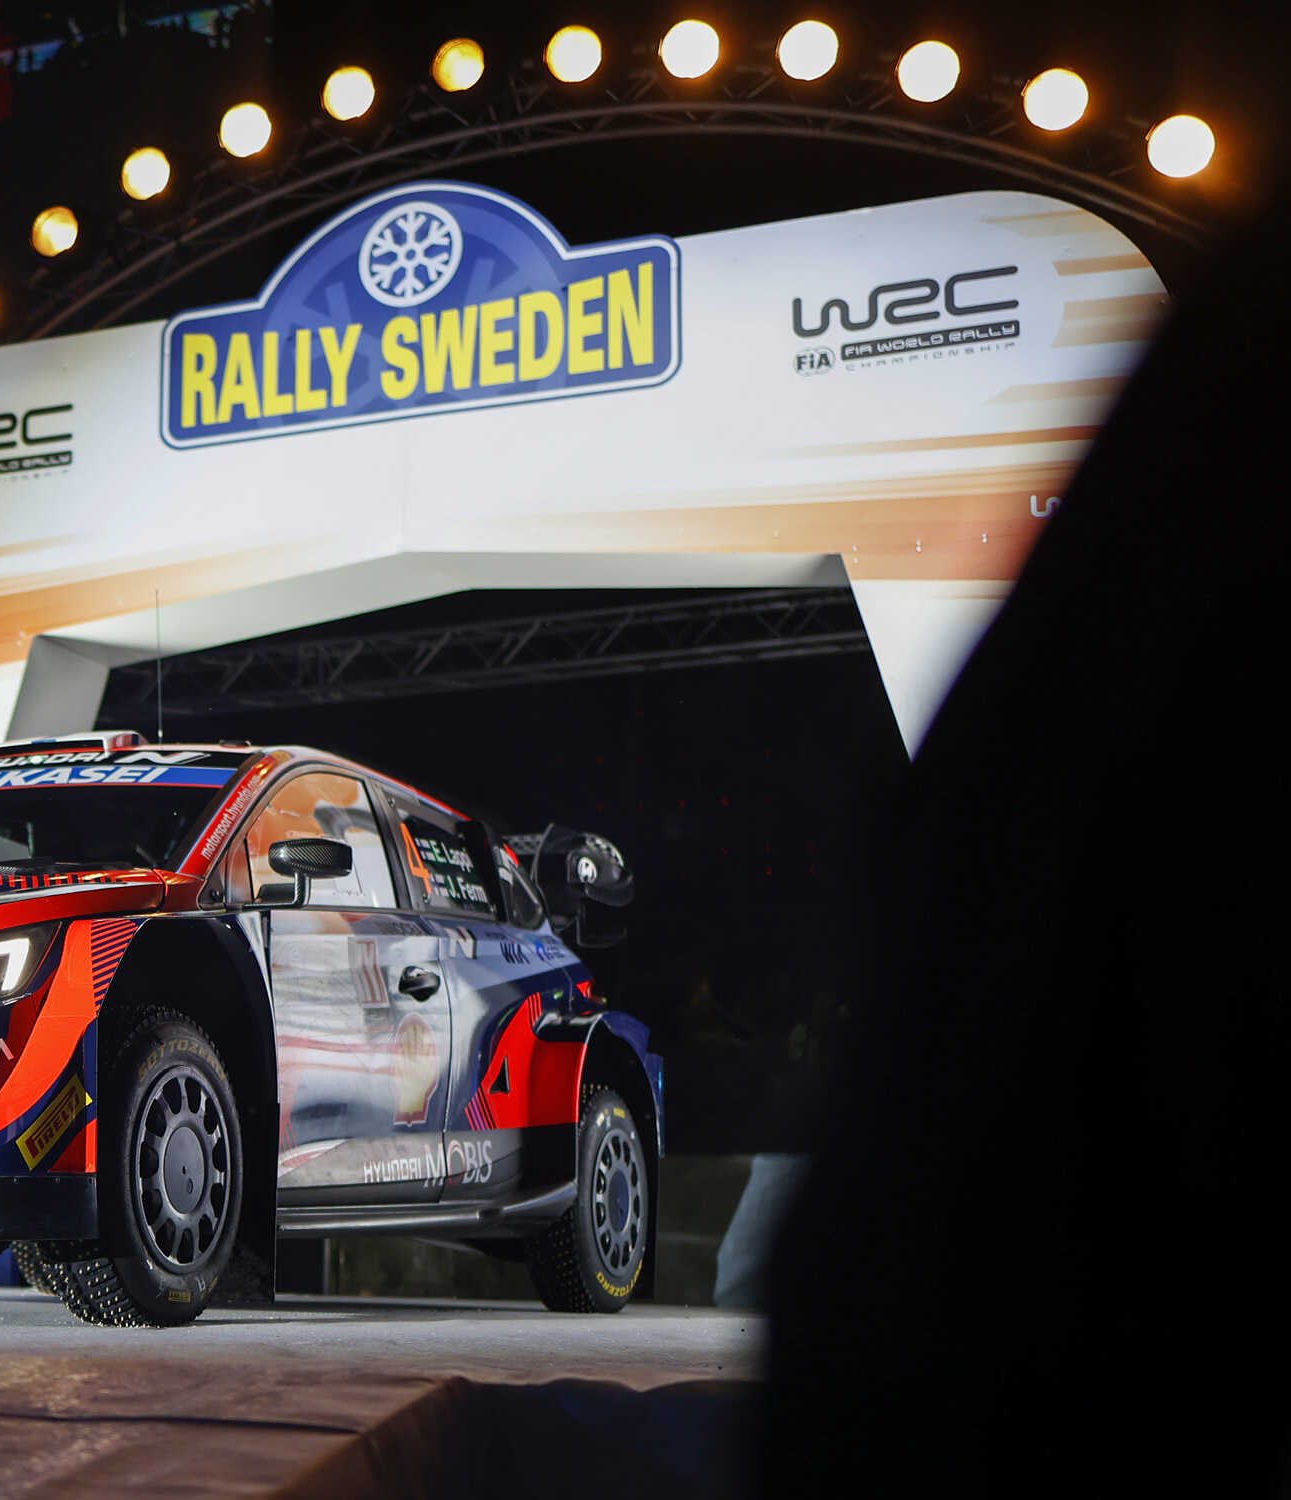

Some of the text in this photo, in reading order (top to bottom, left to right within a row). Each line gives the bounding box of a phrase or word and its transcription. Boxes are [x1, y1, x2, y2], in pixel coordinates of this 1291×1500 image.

[793, 265, 1019, 338] WRC
[181, 261, 655, 428] RALLY SWEDEN
[844, 323, 1016, 357] FIA WORLD RALLY
[22, 454, 70, 469] RALLY
[399, 822, 432, 895] 4
[364, 1140, 493, 1189] HYUNDAI MOBIS
